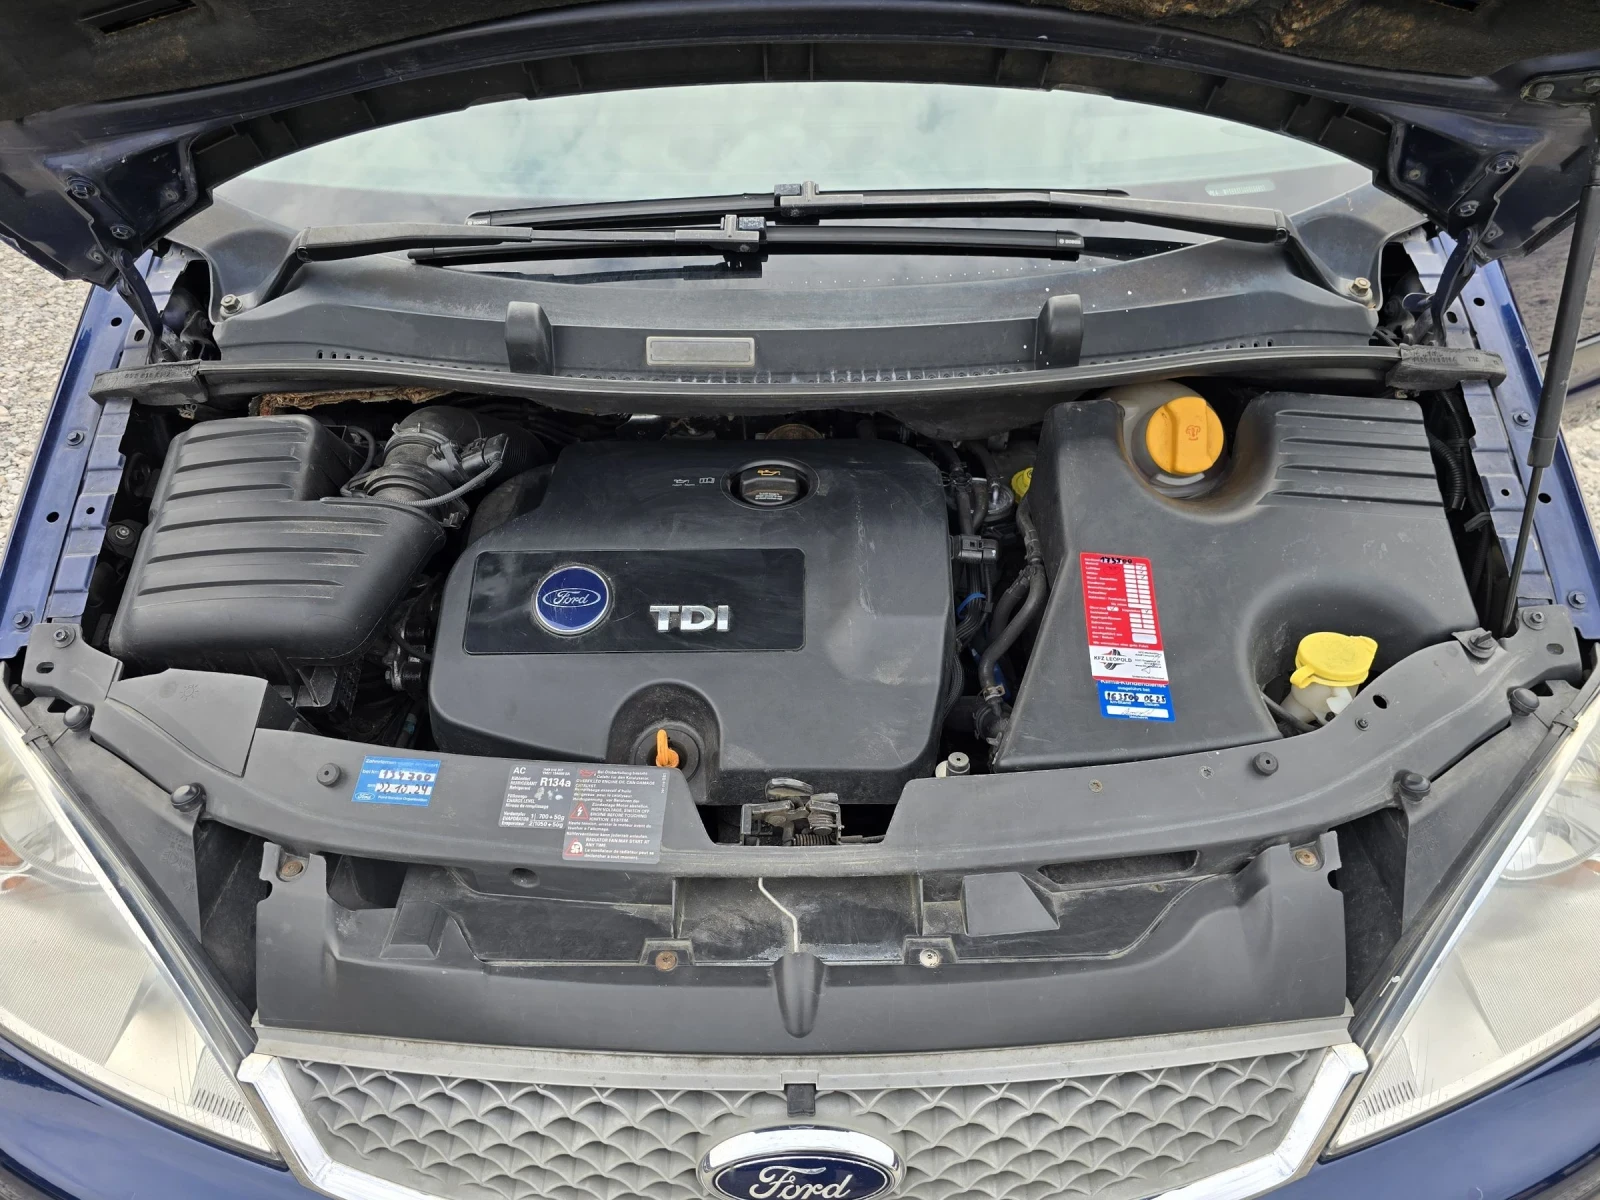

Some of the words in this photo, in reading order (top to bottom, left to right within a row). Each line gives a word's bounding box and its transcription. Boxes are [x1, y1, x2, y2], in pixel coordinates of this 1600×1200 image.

[553, 590, 590, 606] Ford
[649, 604, 730, 633] TDI
[1105, 656, 1133, 664] LEOPOLD
[513, 766, 526, 775] AC
[539, 777, 572, 788] R134a
[748, 1165, 853, 1200] Ford
